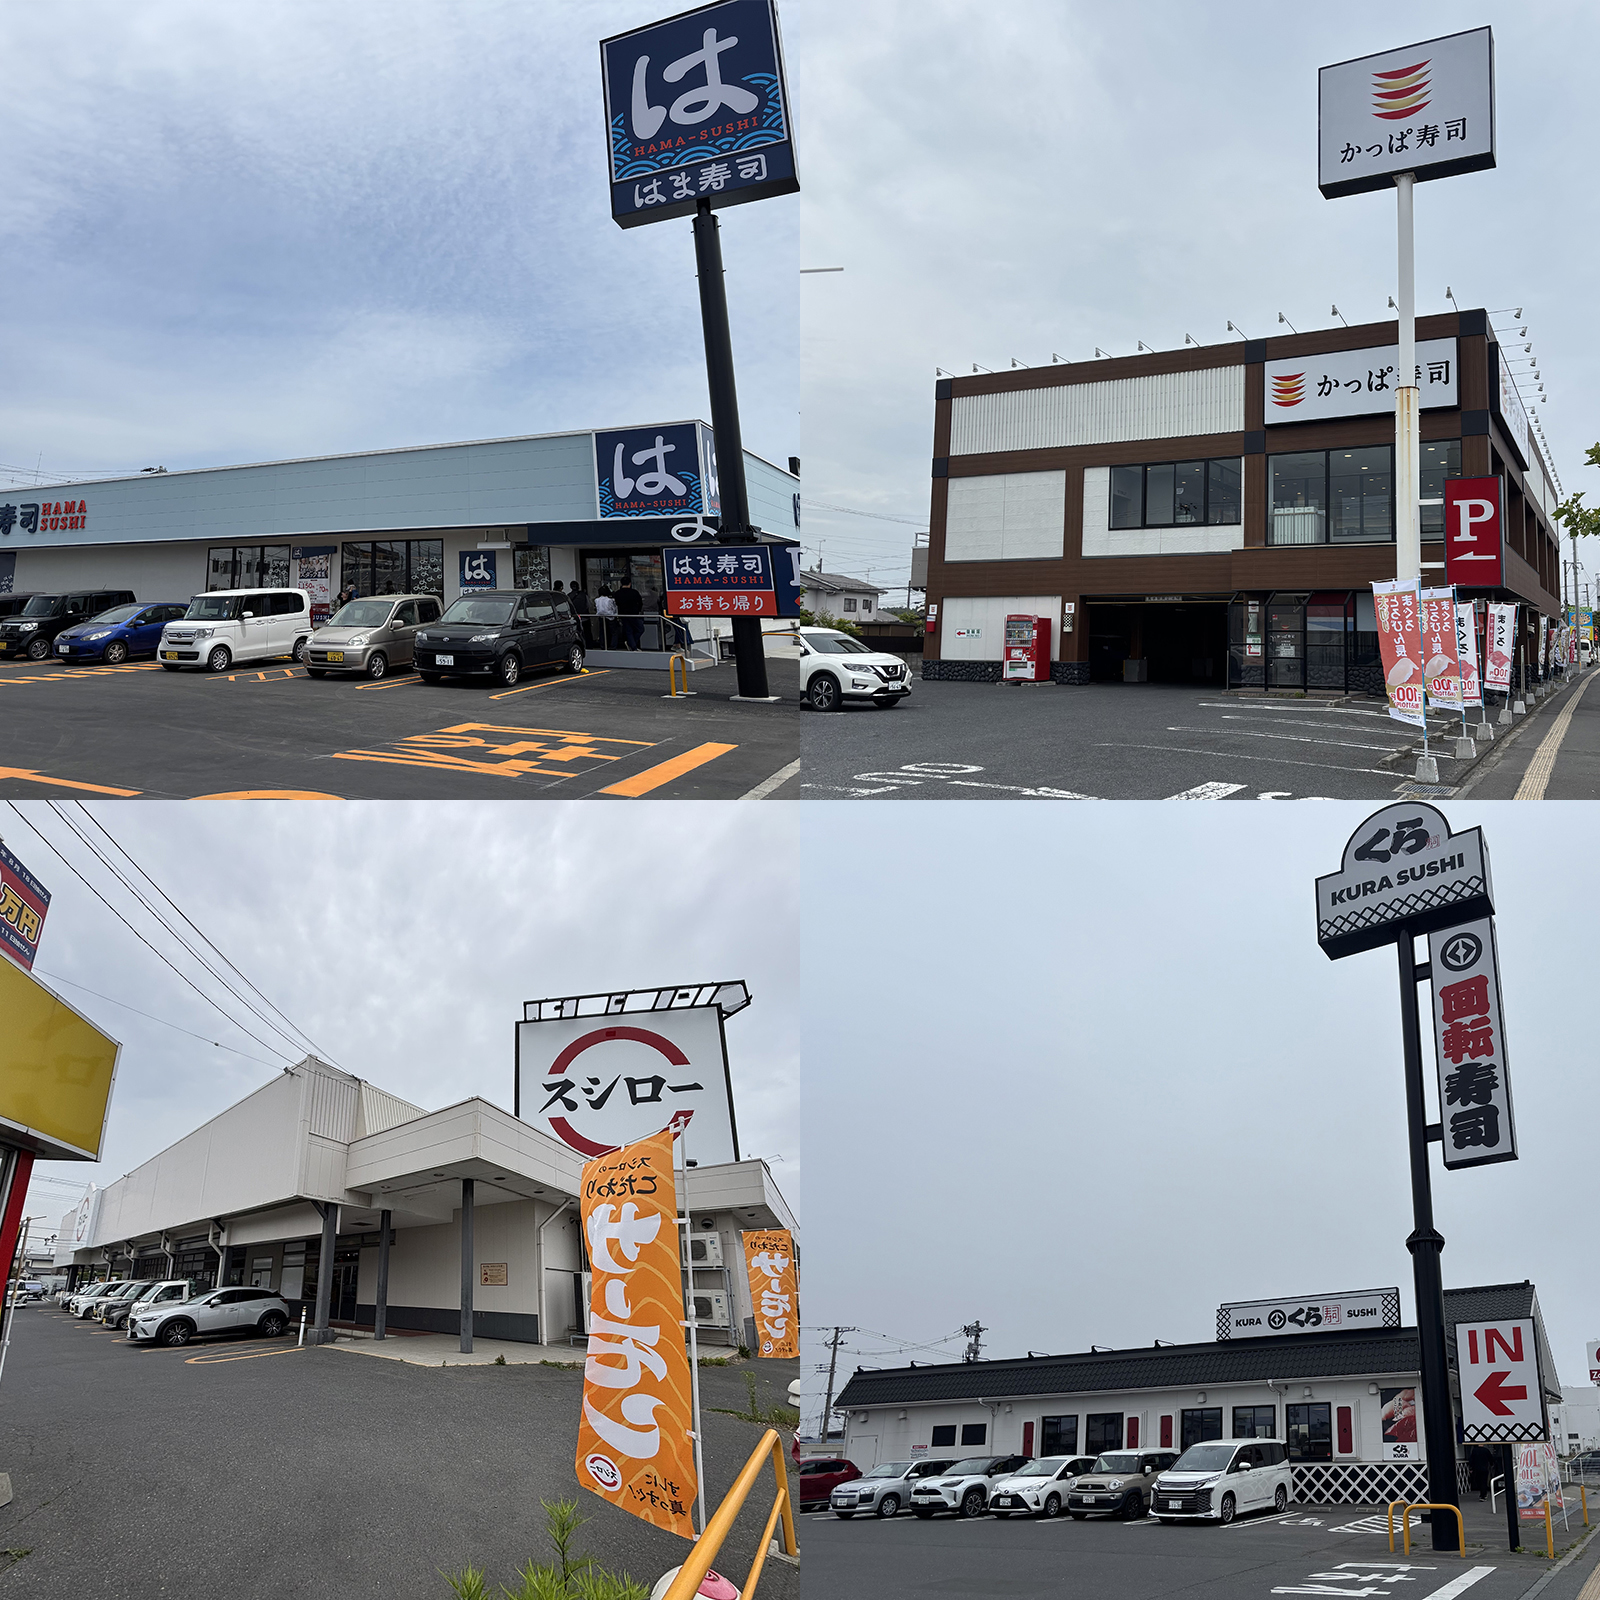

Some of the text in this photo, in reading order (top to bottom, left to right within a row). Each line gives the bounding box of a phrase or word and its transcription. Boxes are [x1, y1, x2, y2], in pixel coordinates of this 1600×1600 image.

[632, 27, 759, 140] は
[634, 116, 759, 157] HAMA-SUSHI
[1340, 117, 1467, 164] かっぱ寿司
[634, 153, 768, 208] はま寿司
[613, 435, 687, 499] は
[40, 514, 86, 532] SUSHI
[41, 499, 87, 516] HAMA
[615, 499, 687, 509] HAMA-SUSHI
[1453, 499, 1495, 542] P
[464, 554, 491, 581] は
[673, 554, 762, 575] はま寿司
[674, 575, 764, 585] HAMA-SUSHI
[679, 595, 765, 611] お持ち帰り
[1331, 853, 1465, 907] KURA SUSHI
[1439, 974, 1500, 1150] 回転寿司
[538, 1073, 704, 1113] スシロー
[1235, 1317, 1262, 1328] KURA
[1346, 1307, 1377, 1318] SUSHI
[1467, 1326, 1524, 1365] IN
[1392, 1444, 1408, 1454] くら
